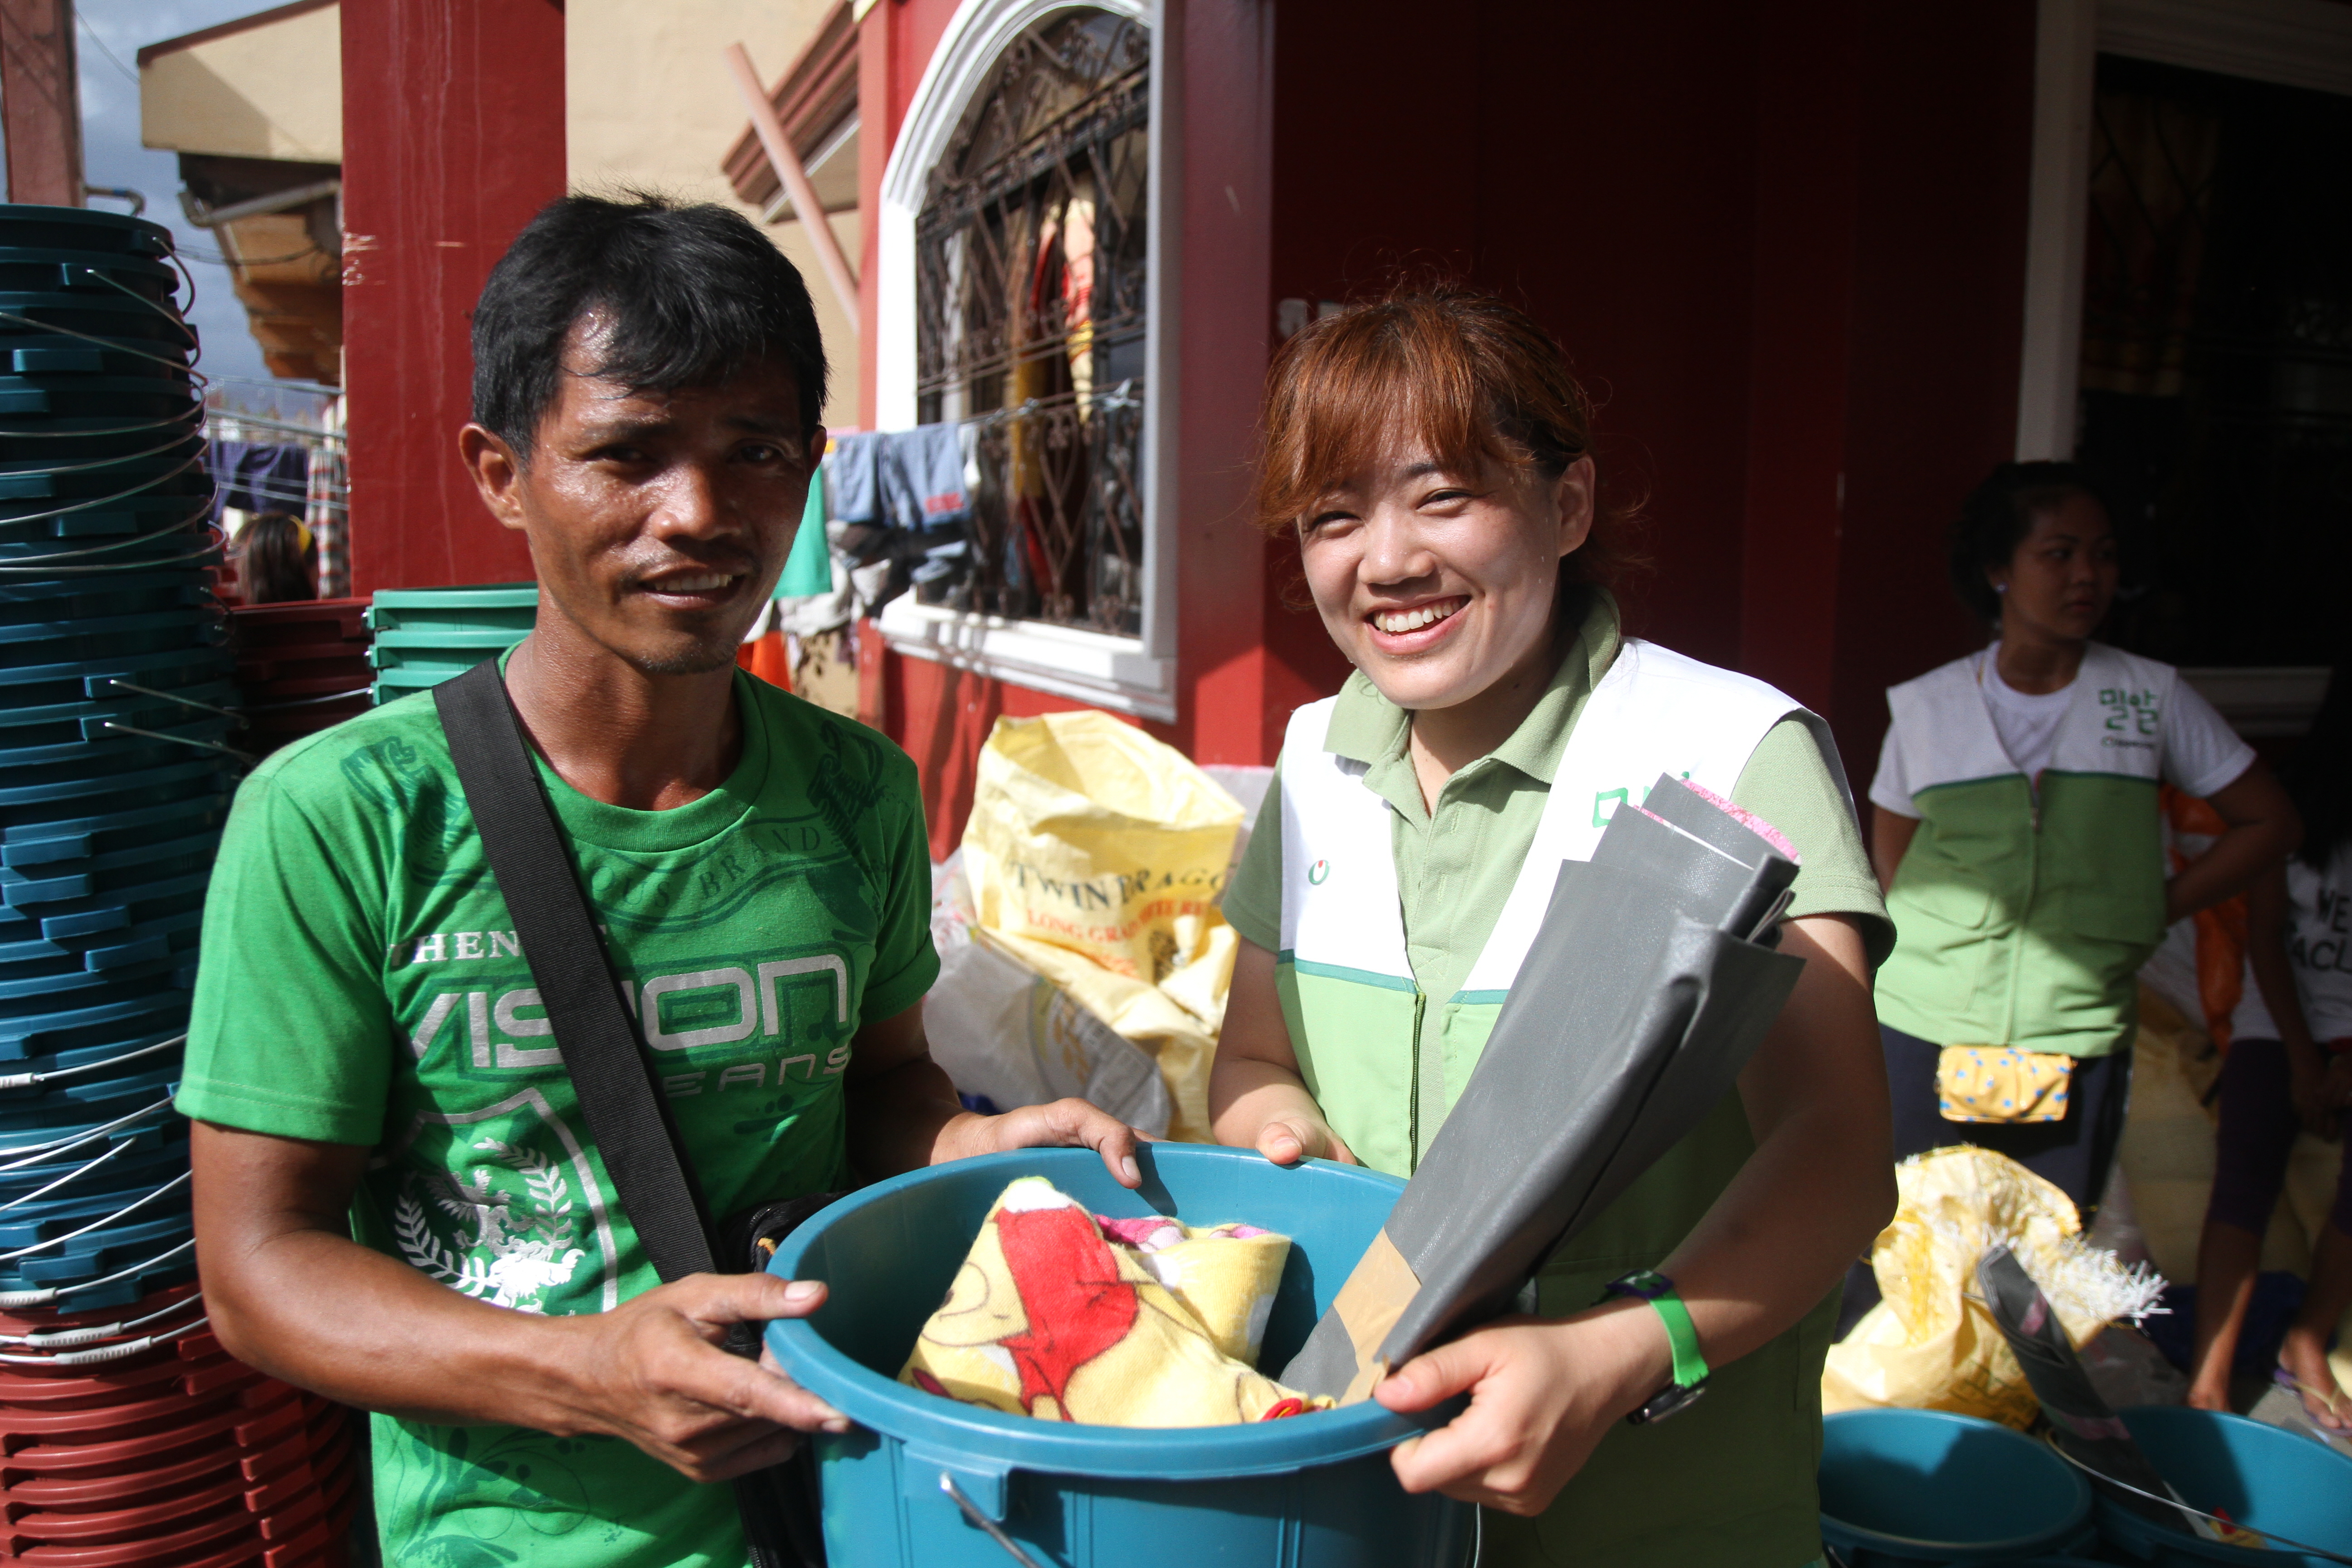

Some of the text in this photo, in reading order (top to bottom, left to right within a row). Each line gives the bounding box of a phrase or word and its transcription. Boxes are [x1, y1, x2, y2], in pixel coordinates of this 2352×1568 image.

[575, 825, 822, 908] OUS BRAND
[1011, 861, 1111, 911] TWIN
[401, 954, 847, 1068] VISON
[663, 1044, 848, 1098] EANS
